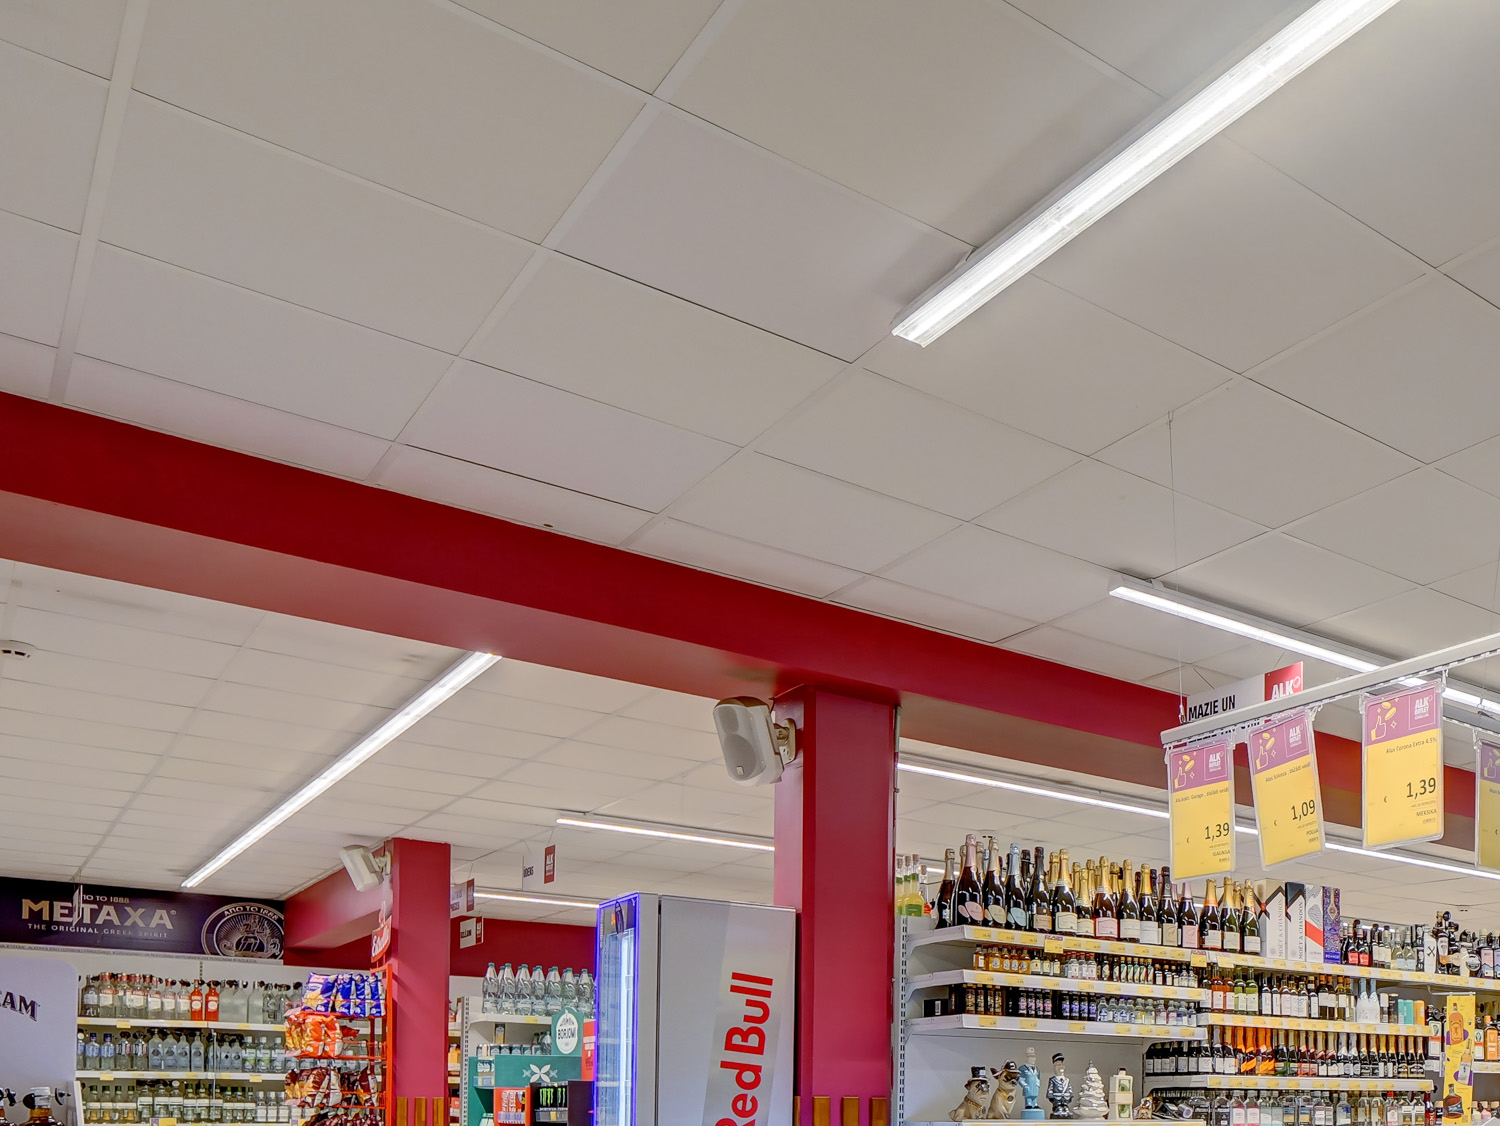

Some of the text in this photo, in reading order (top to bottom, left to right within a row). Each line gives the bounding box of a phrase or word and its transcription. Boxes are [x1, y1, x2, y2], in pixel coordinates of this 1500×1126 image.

[1188, 695, 1235, 721] MAZIE UN
[1386, 746, 1395, 754] Alus
[1396, 743, 1412, 752] Corona
[1413, 740, 1424, 748] Extra
[1406, 777, 1436, 800] 1,39
[1291, 799, 1315, 822] 1,09
[1416, 808, 1437, 817] MEKSIKA
[1205, 822, 1230, 841] 1,39
[21, 898, 174, 929] METAXA
[28, 923, 47, 931] THE
[51, 925, 99, 934] ORIGINAL
[724, 972, 773, 1055] Bull
[558, 1026, 577, 1040] BORJOMI
